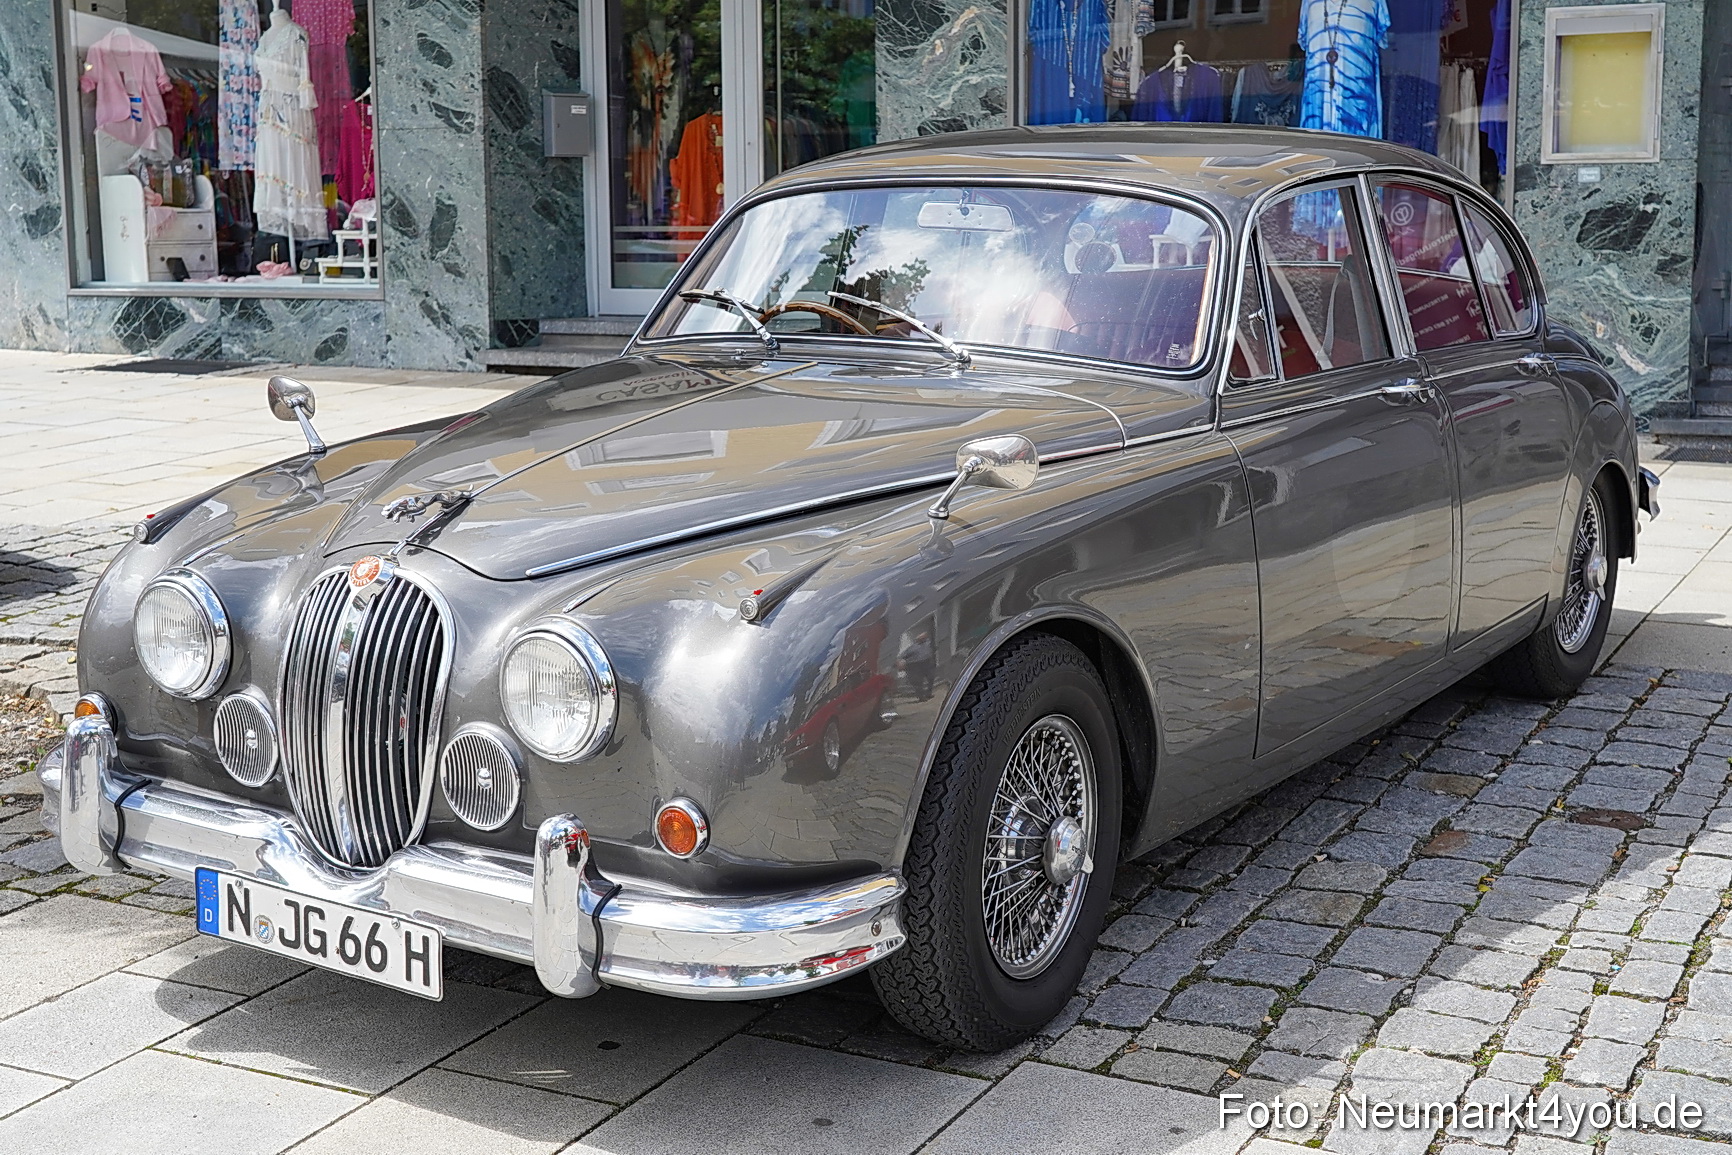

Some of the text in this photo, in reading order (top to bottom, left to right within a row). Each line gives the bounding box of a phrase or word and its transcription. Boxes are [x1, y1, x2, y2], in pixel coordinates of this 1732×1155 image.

[204, 908, 213, 922] D
[227, 883, 250, 936] N
[278, 899, 327, 958] JG
[340, 916, 388, 972] 66
[404, 931, 430, 987] H
